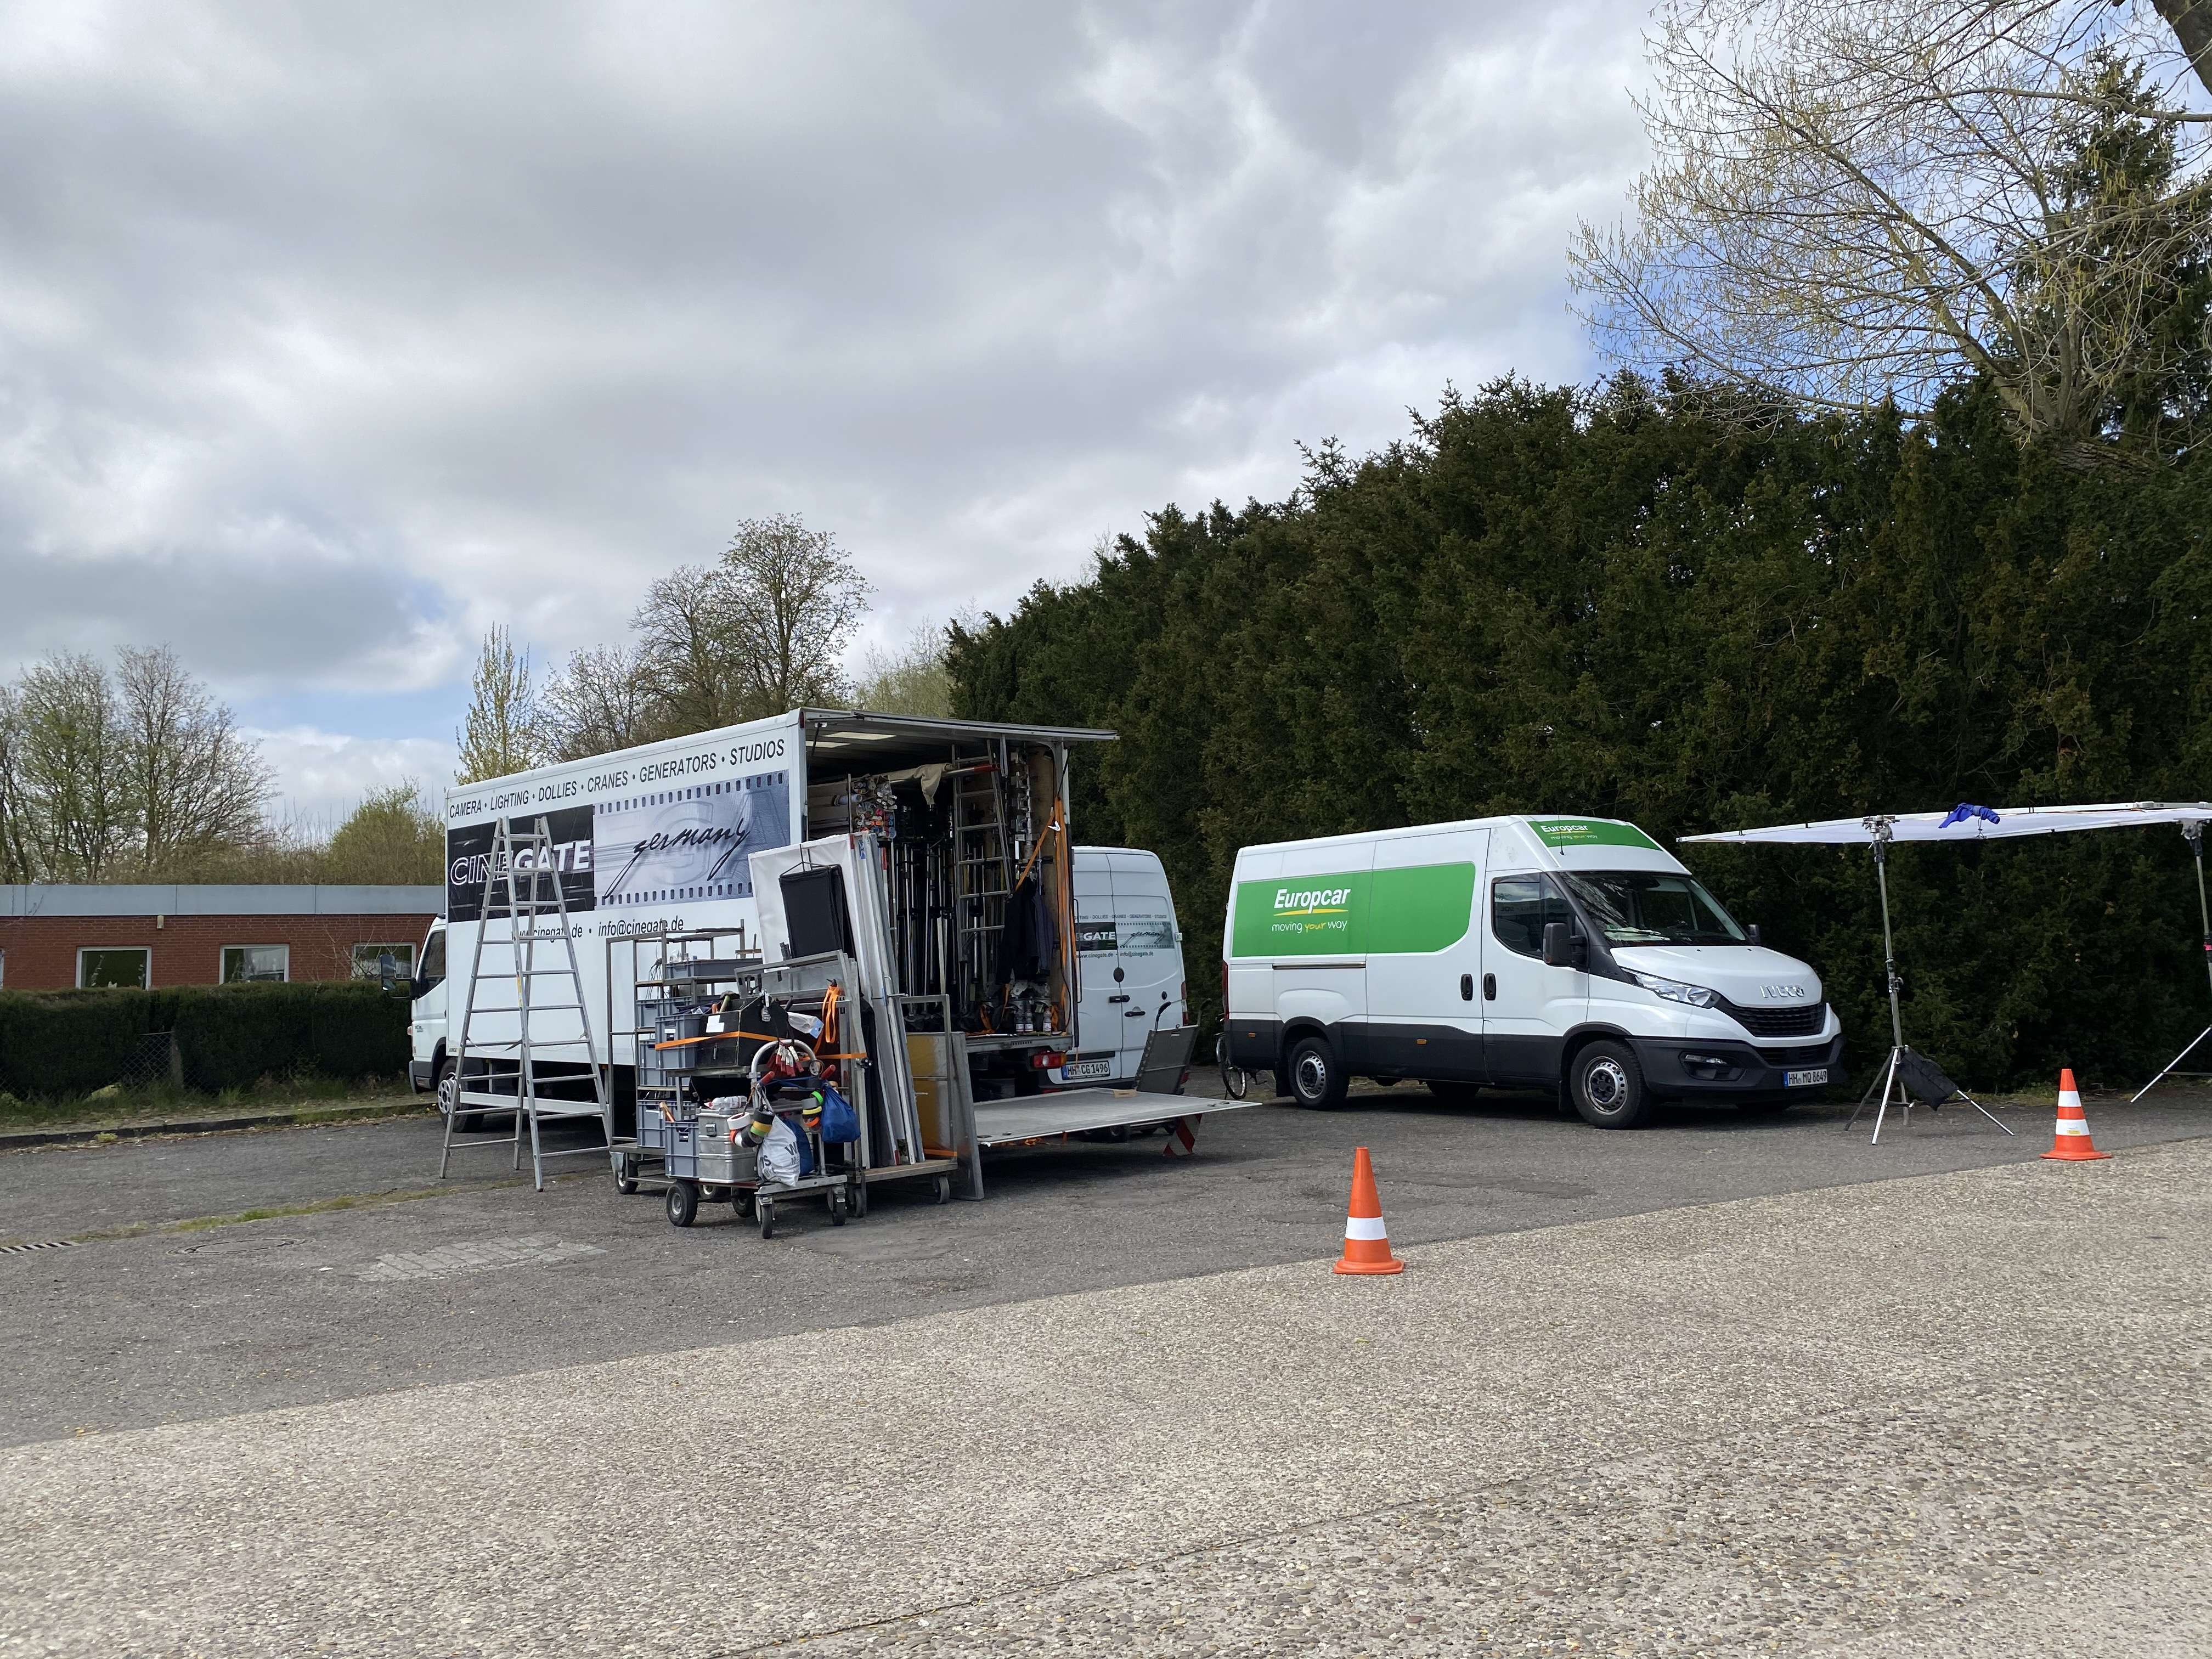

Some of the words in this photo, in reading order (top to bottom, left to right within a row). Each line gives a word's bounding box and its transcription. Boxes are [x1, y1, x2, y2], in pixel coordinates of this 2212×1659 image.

[449, 799, 482, 818] CAMERA
[490, 790, 529, 810] LIGHTING
[538, 781, 577, 802] DOLLIES
[588, 770, 628, 792] CRANES
[640, 752, 716, 782] GENERATORS
[730, 738, 785, 765] STUDIOS
[603, 817, 751, 899] germany
[1274, 888, 1351, 914] Europcar
[1272, 921, 1302, 933] moving
[1304, 922, 1327, 933] your
[1328, 921, 1348, 932] way
[1759, 985, 1804, 998] IVECO
[1068, 1065, 1076, 1075] HH
[1081, 1064, 1090, 1074] CG
[1091, 1063, 1108, 1074] 1496
[1789, 1073, 1798, 1085] HH
[1802, 1072, 1812, 1084] MQ
[1812, 1070, 1827, 1083] 8649
